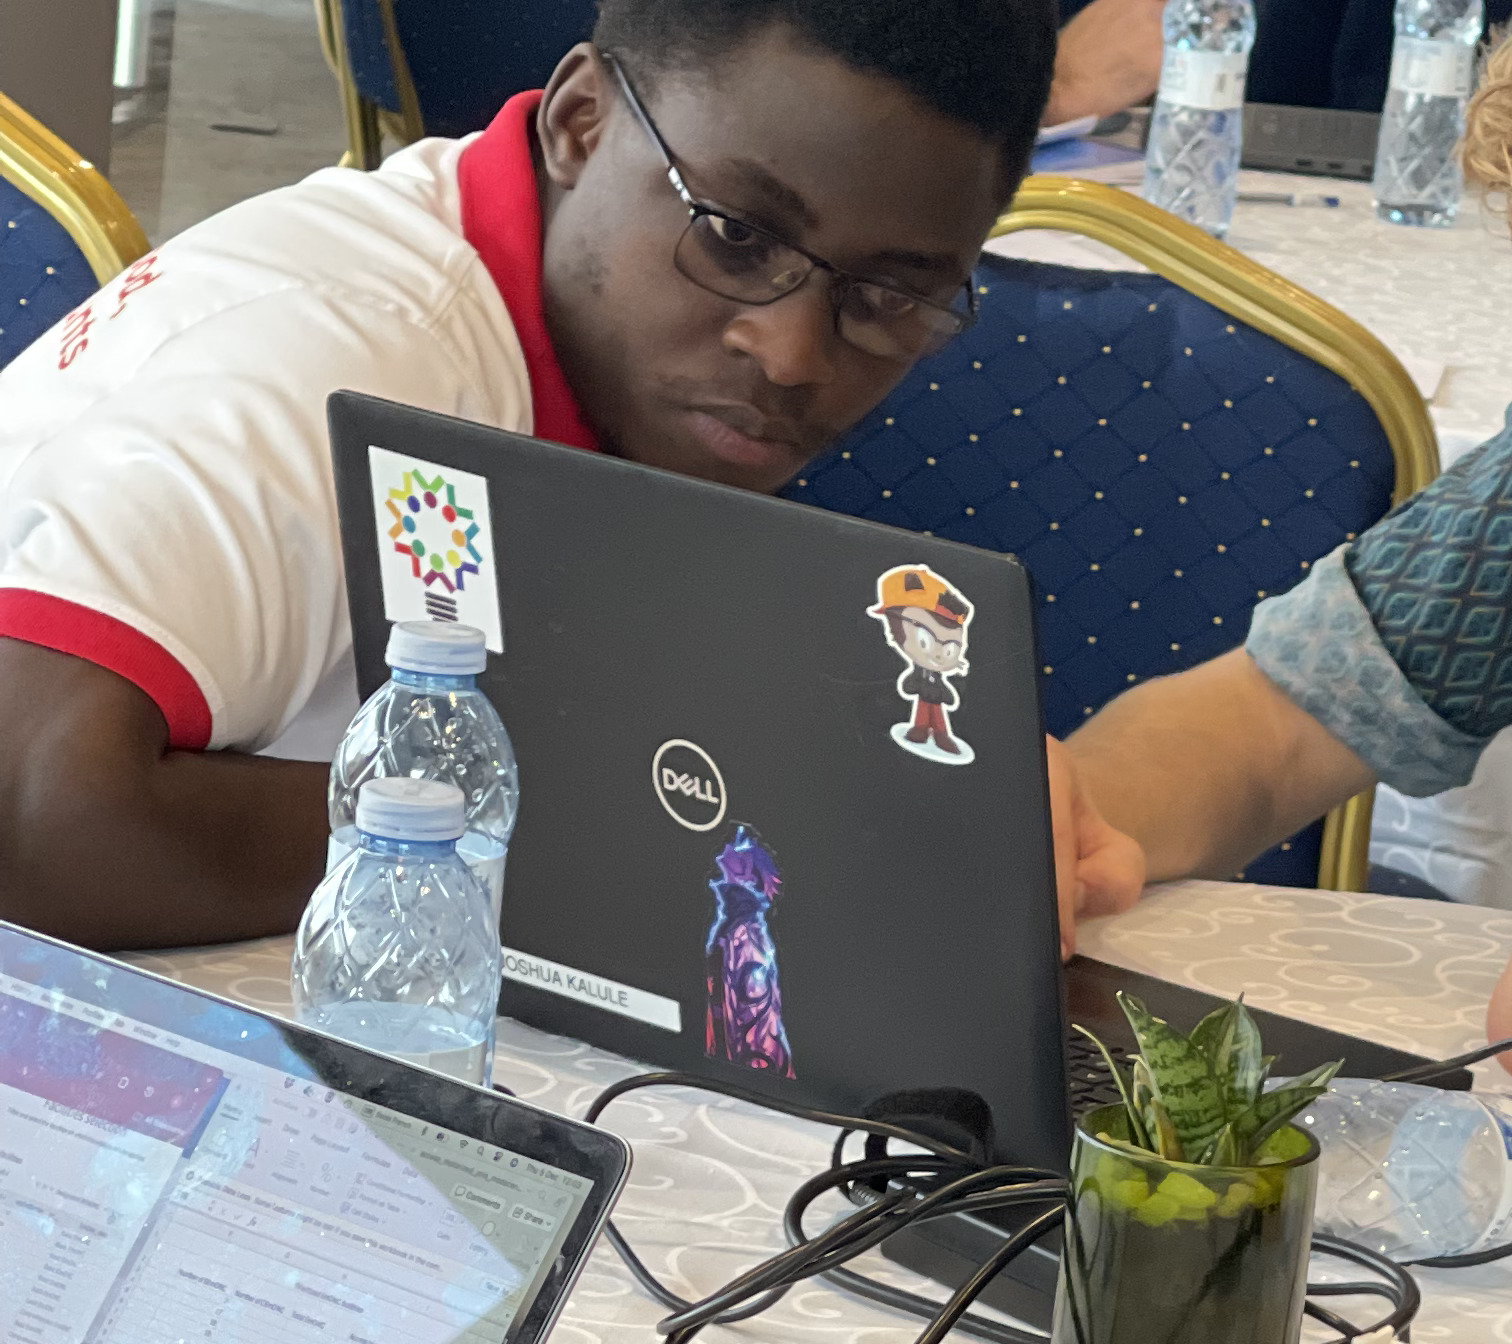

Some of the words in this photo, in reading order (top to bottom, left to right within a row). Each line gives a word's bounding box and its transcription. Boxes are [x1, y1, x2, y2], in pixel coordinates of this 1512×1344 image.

[662, 767, 719, 804] DELL
[501, 954, 563, 987] OSHUA
[566, 973, 630, 1007] KALULE
